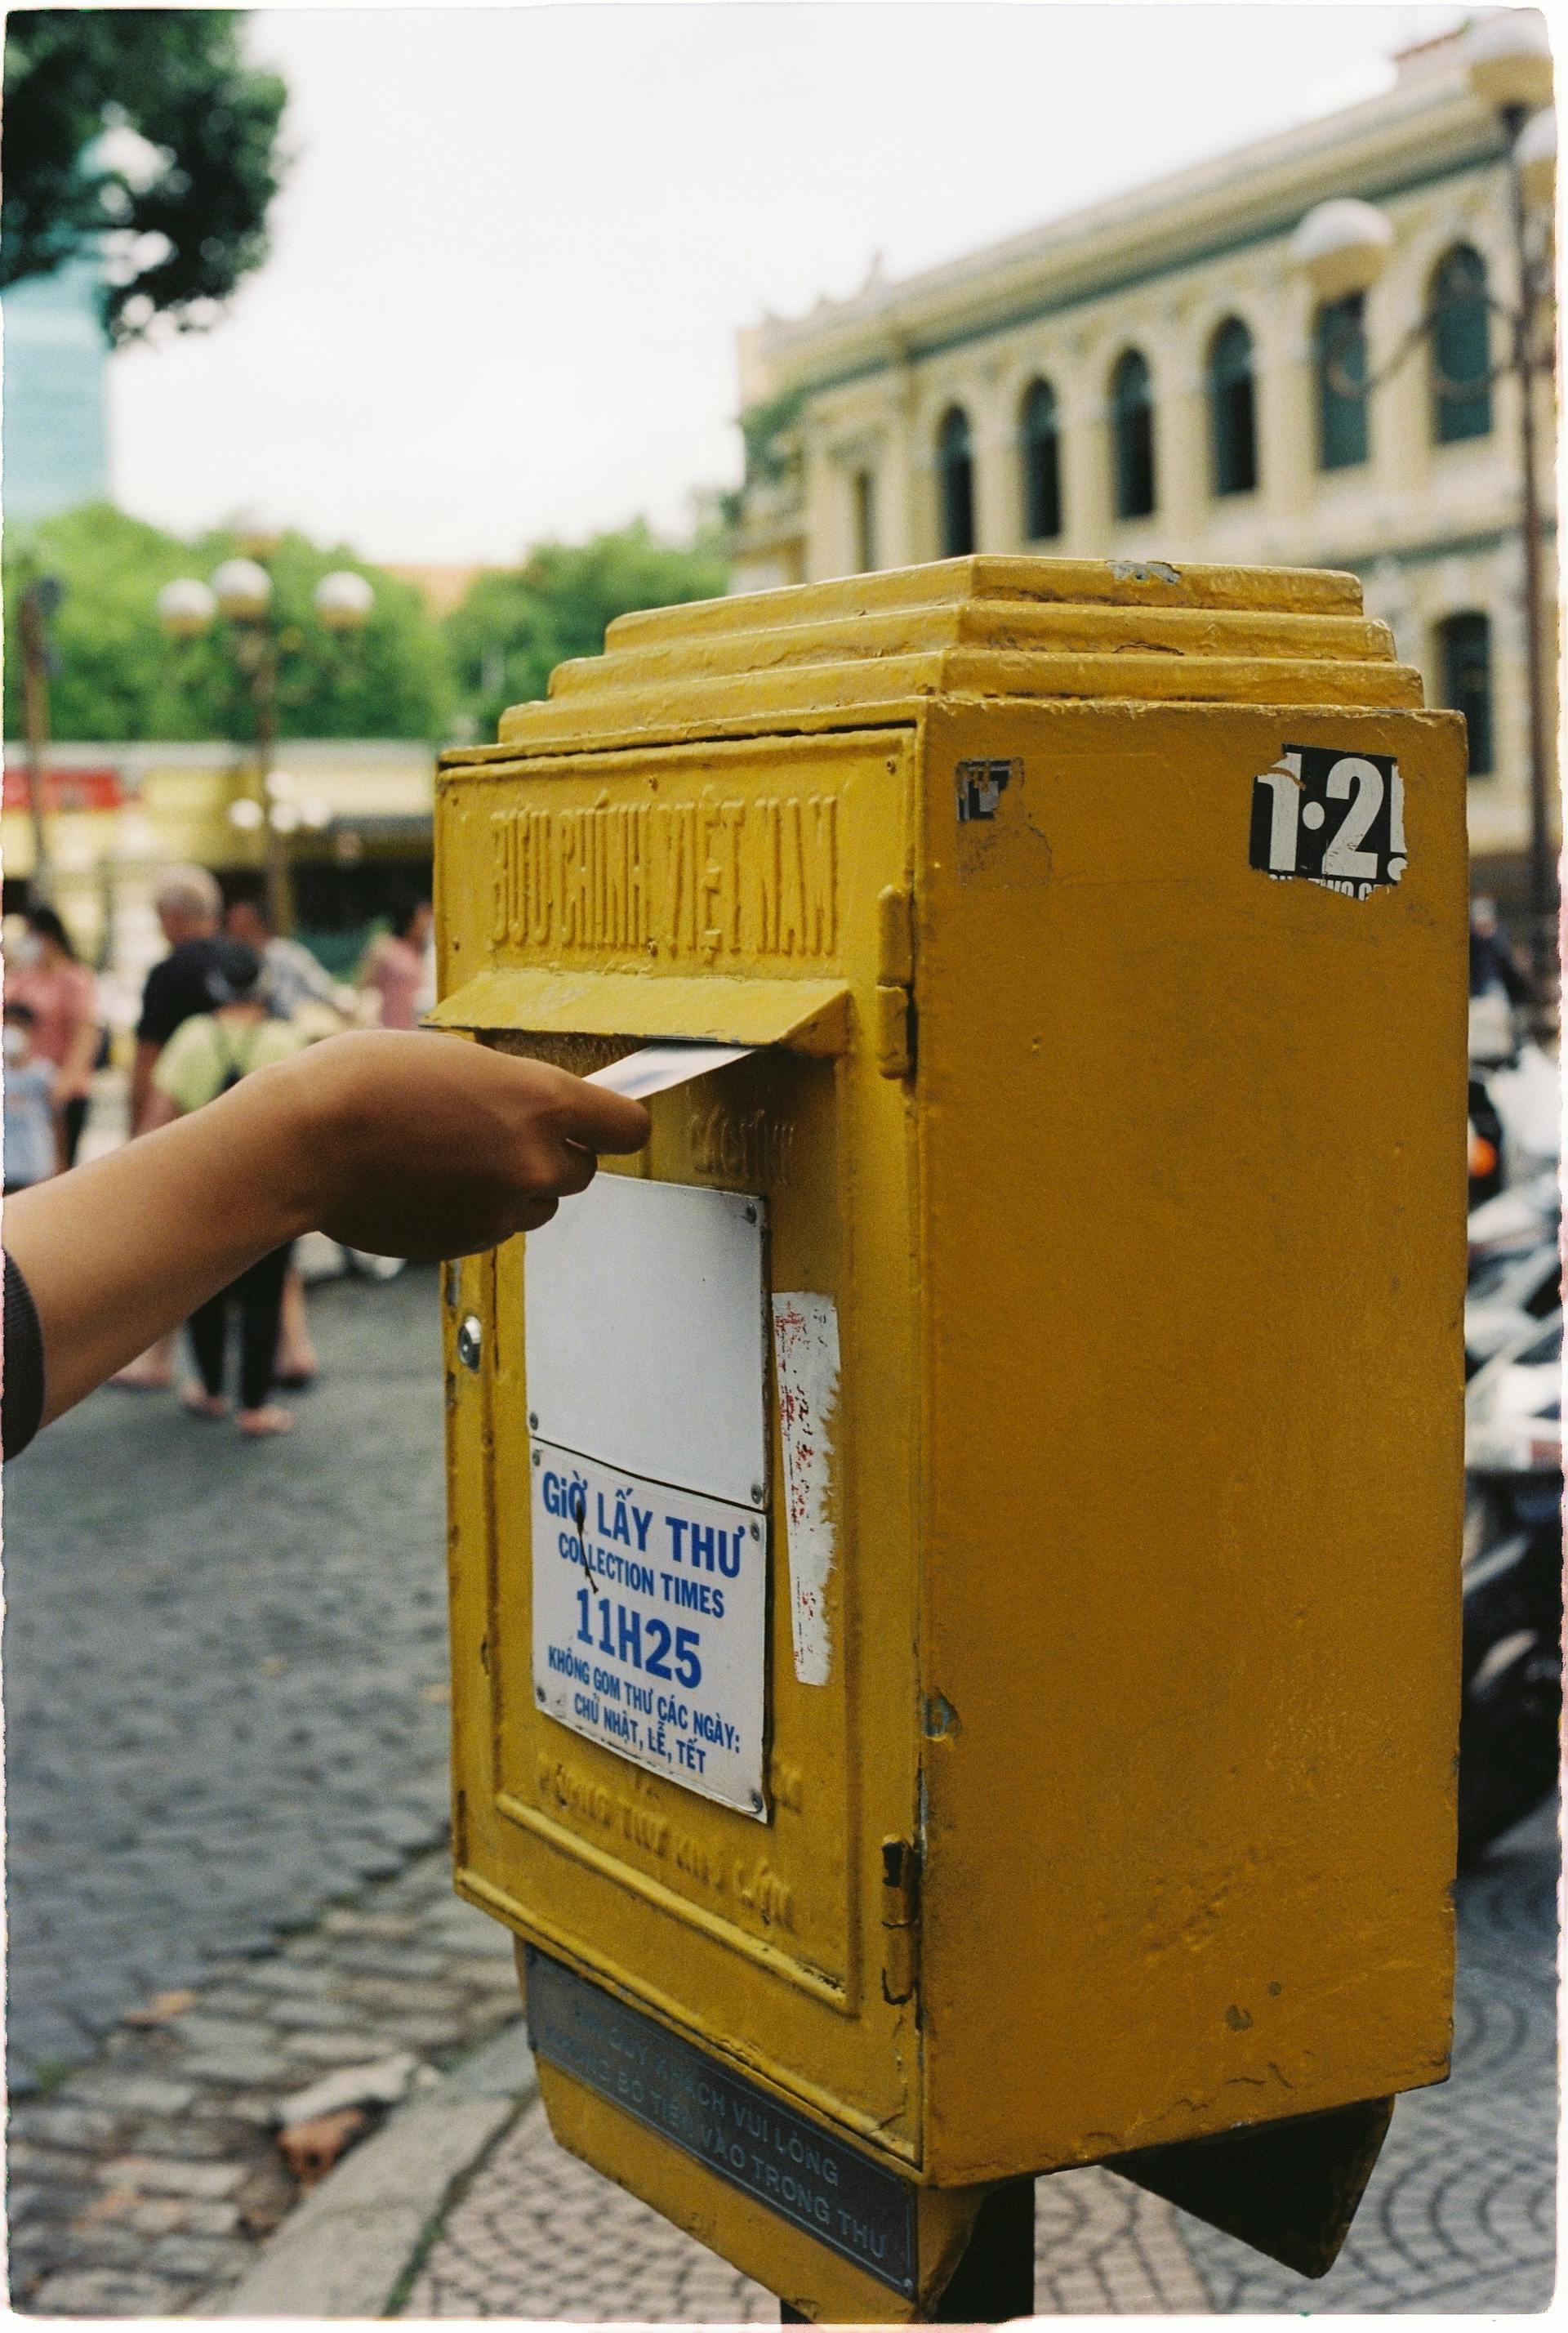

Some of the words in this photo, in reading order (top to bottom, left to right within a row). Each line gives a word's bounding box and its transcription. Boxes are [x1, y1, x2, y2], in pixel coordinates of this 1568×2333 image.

[753, 796, 838, 956] NAM
[559, 1532, 654, 1596] COLLECTION
[660, 1572, 724, 1618] TIMES
[597, 1488, 653, 1552] LẤY
[666, 1515, 746, 1578] THƯ
[577, 1588, 702, 1689] 11H25
[548, 1645, 590, 1685] KHÔNG
[594, 1667, 621, 1701] GOM
[624, 1682, 653, 1715] THƯ
[657, 1695, 688, 1729] CÁC
[693, 1711, 740, 1754] NGÀY:
[604, 1706, 644, 1751] NHẬT,
[676, 1738, 706, 1773] TẾT
[733, 2103, 768, 2142] VUI
[776, 2127, 839, 2186] LÒNG
[751, 2155, 830, 2225] TRONG
